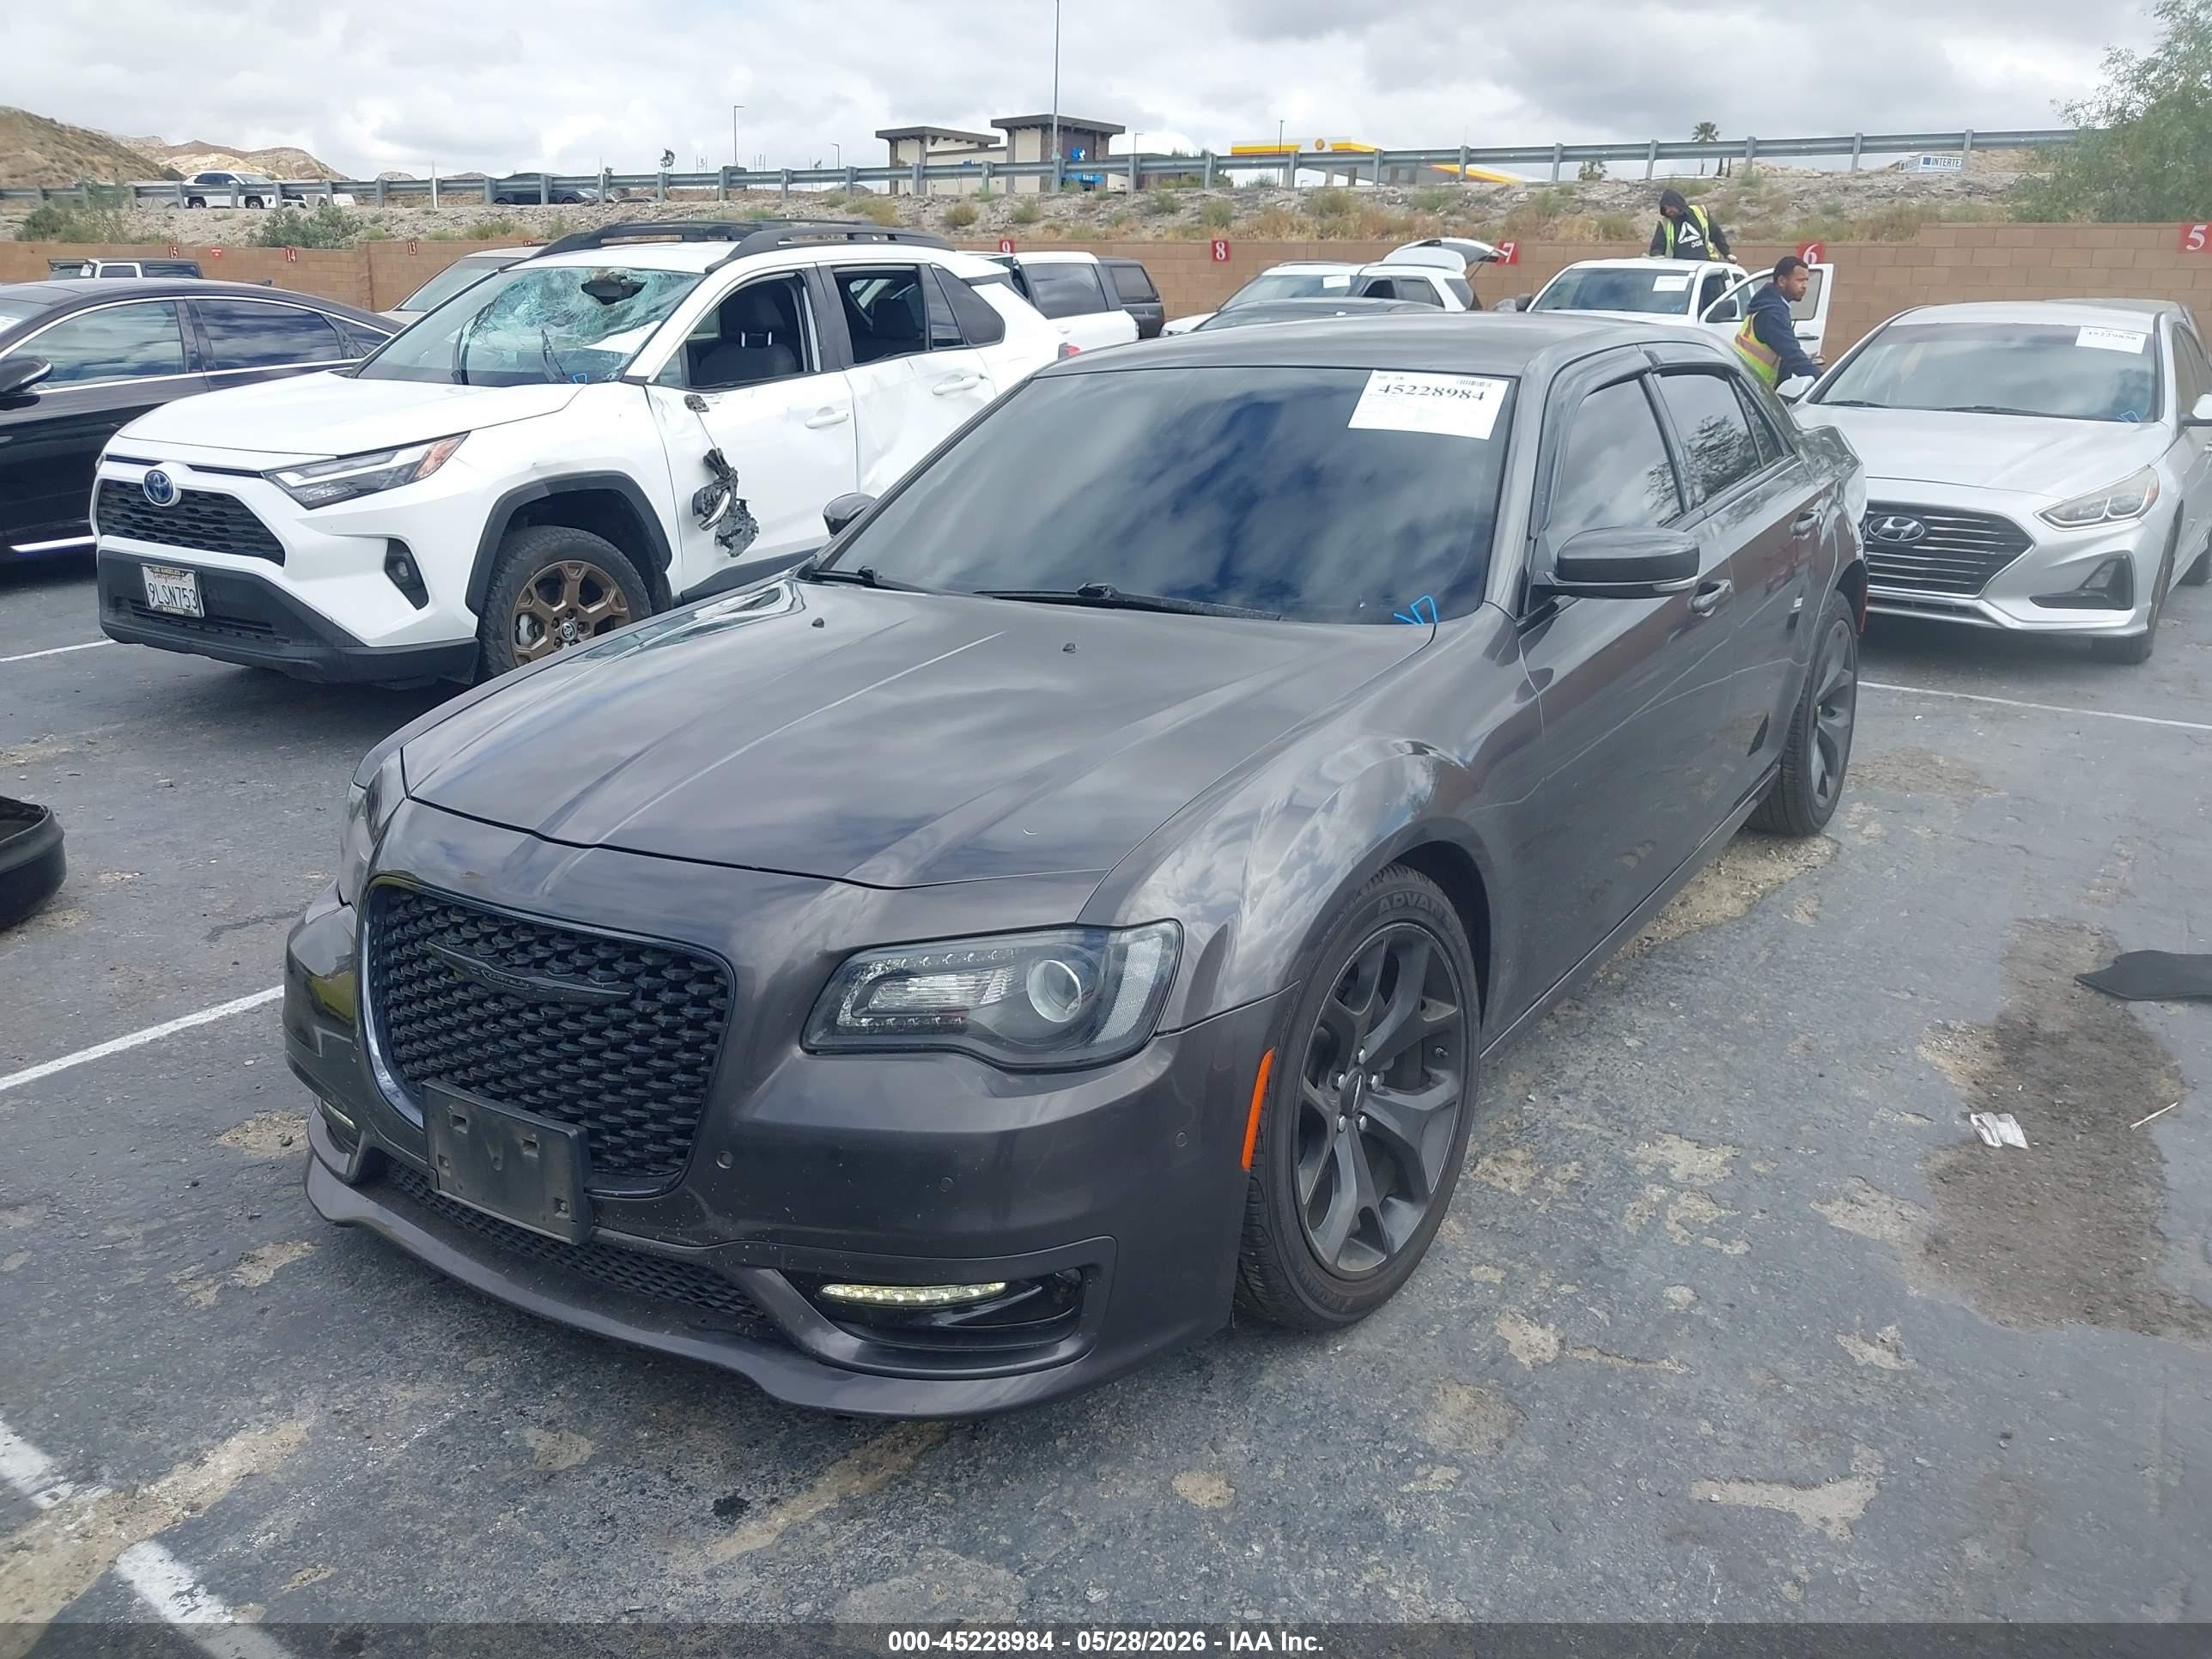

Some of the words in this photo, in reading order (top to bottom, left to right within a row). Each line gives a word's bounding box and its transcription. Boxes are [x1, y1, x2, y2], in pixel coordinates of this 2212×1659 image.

[2186, 224, 2208, 250] 5
[169, 246, 178, 259] 15
[286, 248, 296, 262] 14
[408, 242, 416, 255] 13
[1215, 241, 1226, 260] 8
[1503, 242, 1515, 264] 7
[1803, 244, 1820, 264] 6
[1378, 383, 1486, 402] 45228984
[149, 582, 198, 610] 9LSN753
[1378, 892, 1443, 921] ADVAN
